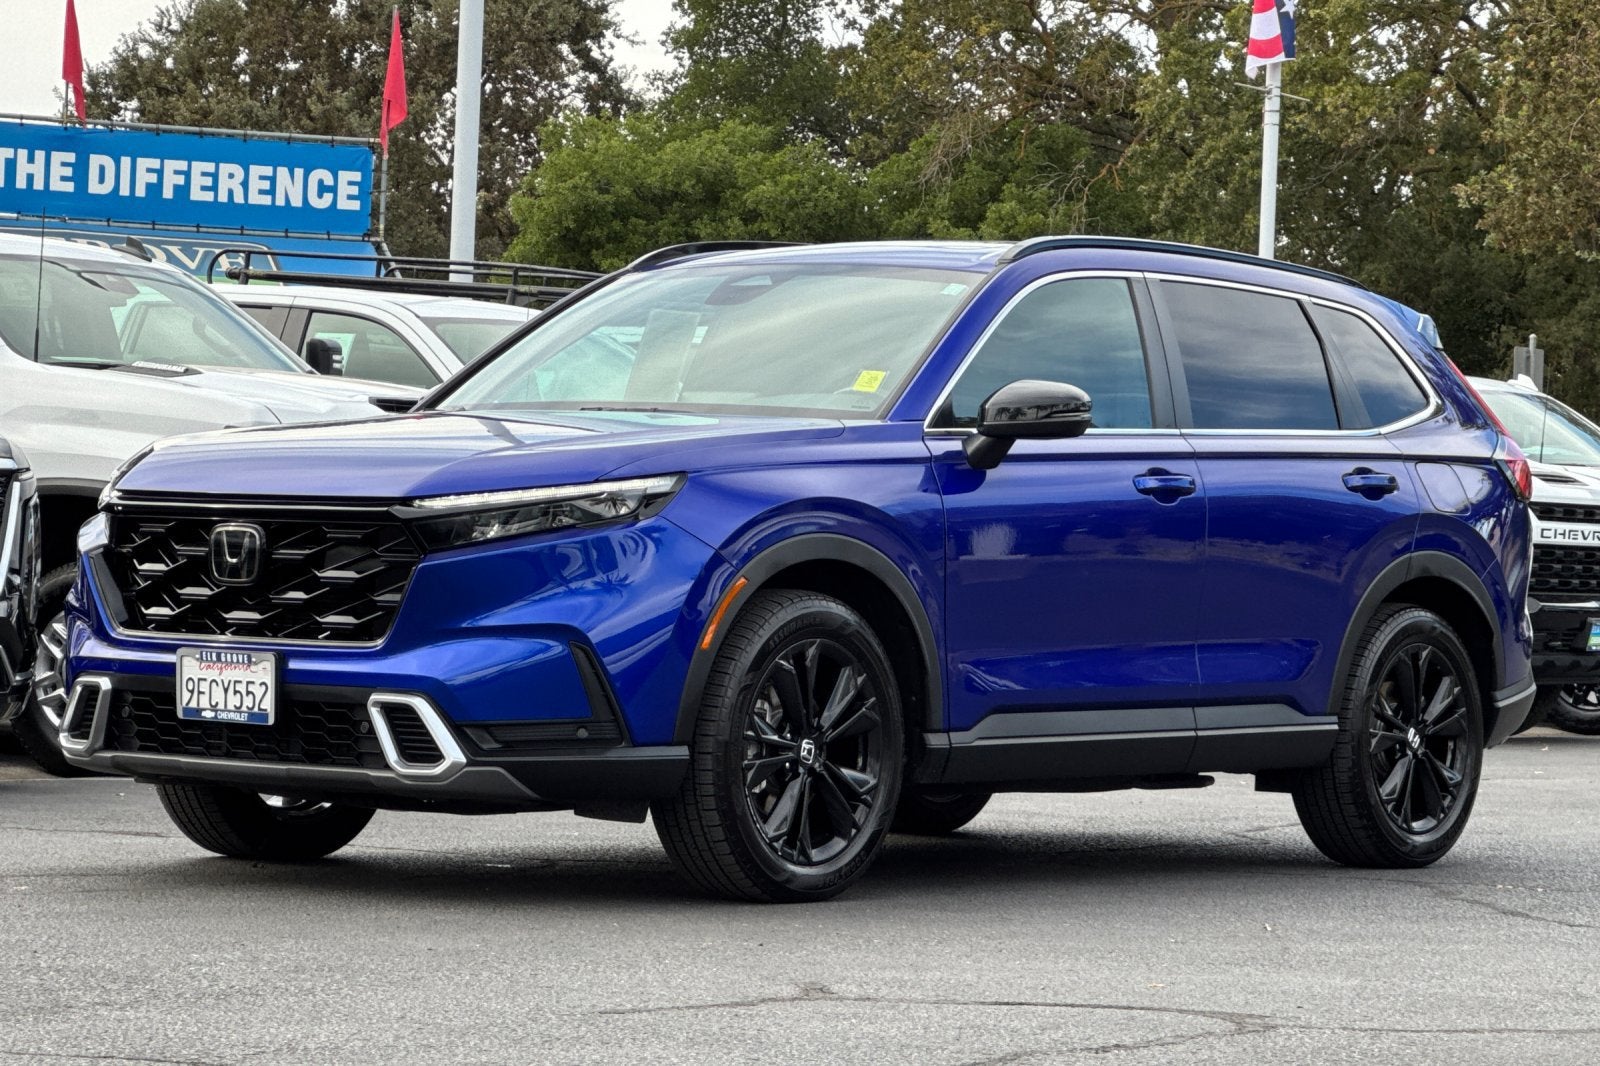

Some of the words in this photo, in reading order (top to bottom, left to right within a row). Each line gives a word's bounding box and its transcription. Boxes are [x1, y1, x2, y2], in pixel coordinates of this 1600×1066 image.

[0, 147, 76, 192] THE
[87, 153, 362, 211] DIFFERENCE
[202, 651, 217, 661] ELK
[220, 652, 249, 664] GROVE
[199, 662, 257, 676] California
[185, 676, 269, 712] 9FCY552
[216, 711, 249, 721] CHEVROLET
